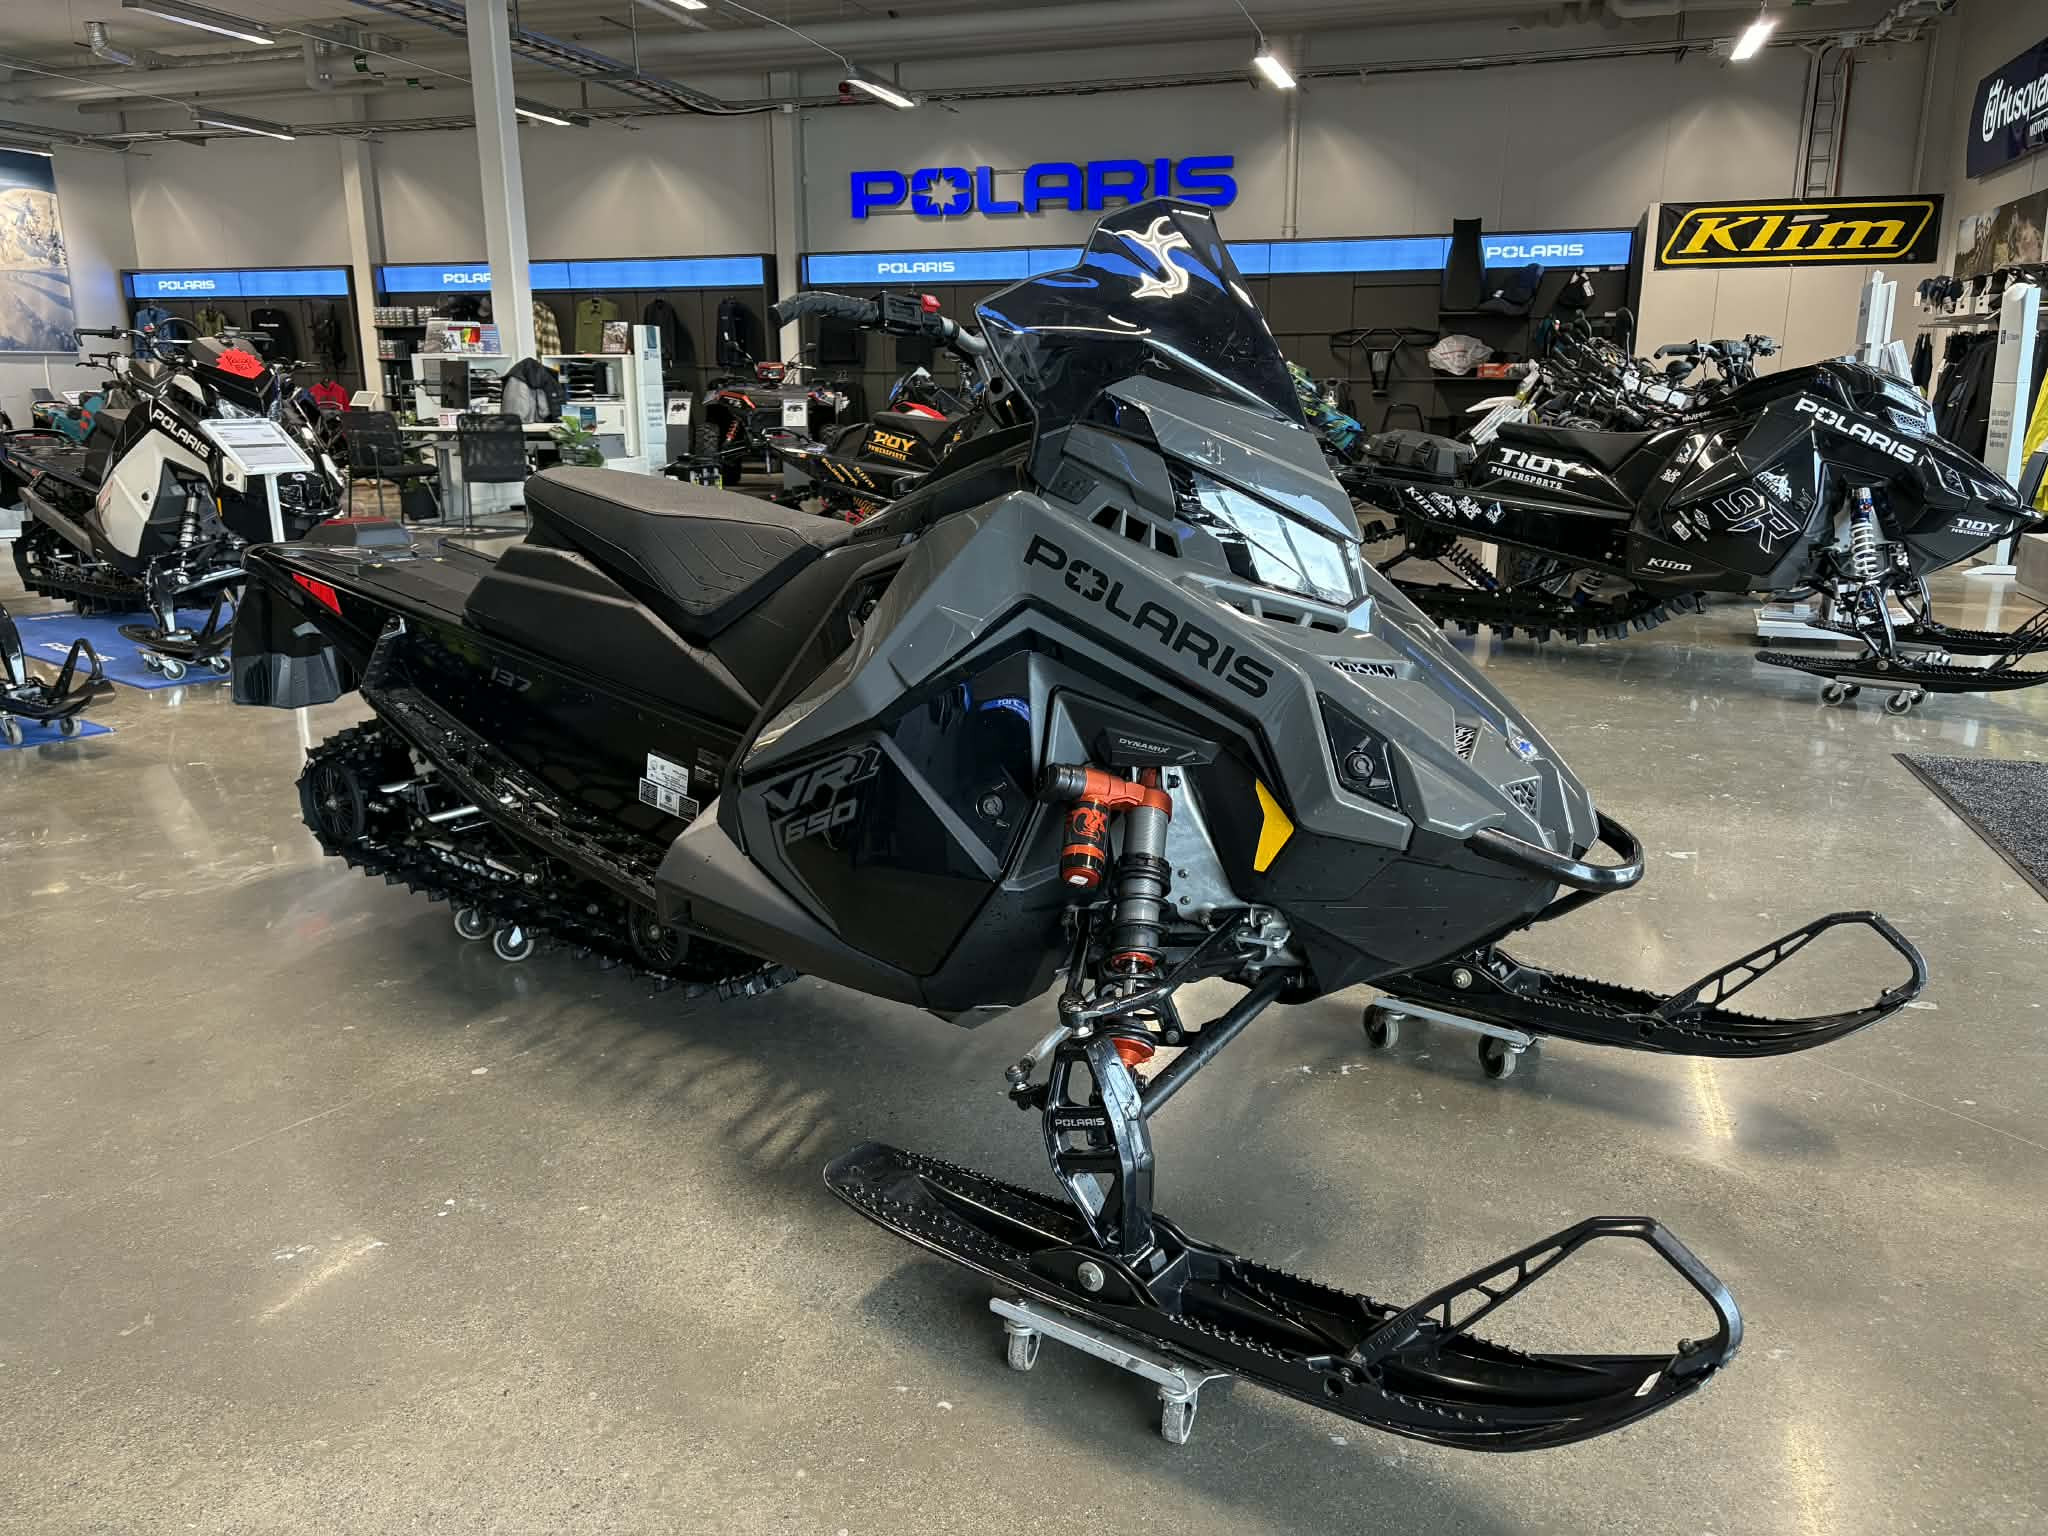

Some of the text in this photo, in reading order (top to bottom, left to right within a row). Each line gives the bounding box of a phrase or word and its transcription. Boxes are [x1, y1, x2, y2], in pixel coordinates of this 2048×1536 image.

[851, 155, 1238, 219] POLARIS
[1677, 213, 1907, 256] Klim
[1486, 243, 1584, 259] POLARIS
[877, 261, 956, 274] POLARIS
[158, 279, 216, 291] POLARIS
[151, 408, 211, 458] POLARIS
[1794, 397, 1919, 464] POLARIS
[1490, 466, 1564, 490] POWERSPORTS
[1404, 486, 1441, 517] Klim
[1648, 557, 1693, 571] Klim
[1023, 534, 1274, 698] POLARIS
[490, 666, 533, 692] 137
[1119, 737, 1170, 754] DYNAMIX
[763, 746, 881, 813] VR1
[784, 797, 858, 847] 650
[1054, 1116, 1106, 1128] POLARIS
